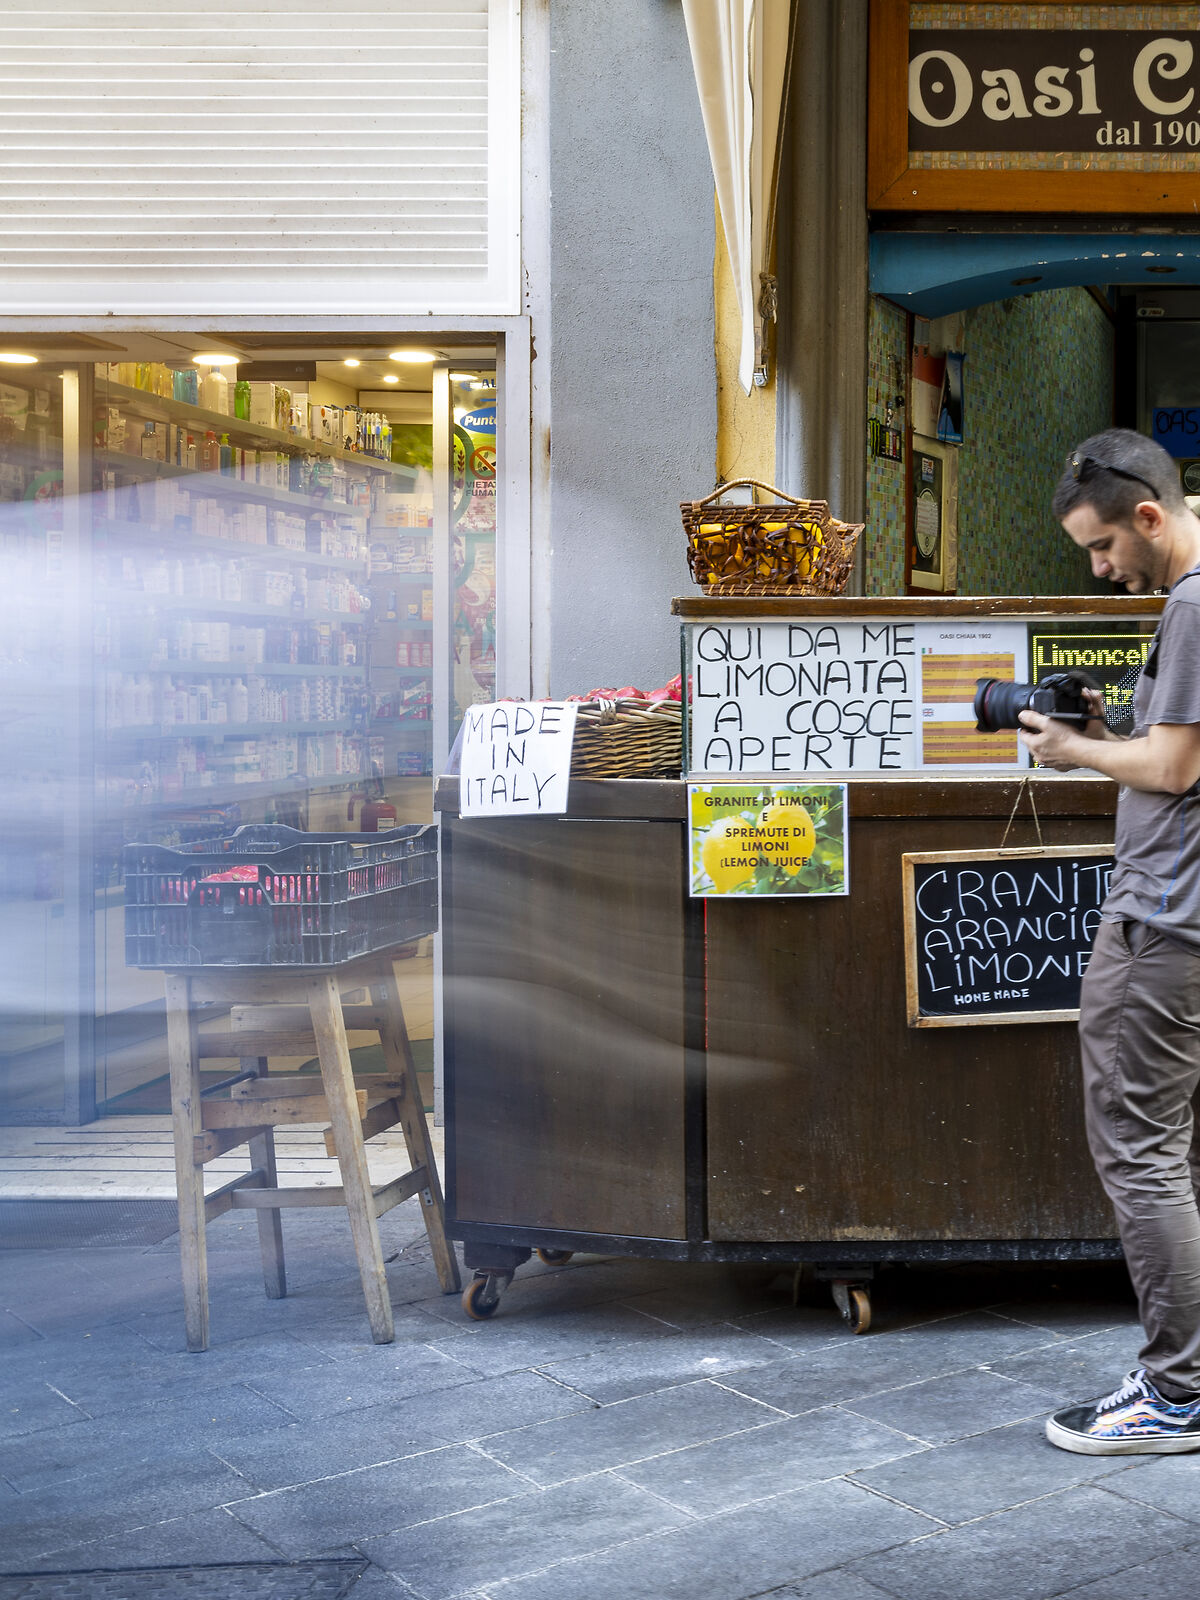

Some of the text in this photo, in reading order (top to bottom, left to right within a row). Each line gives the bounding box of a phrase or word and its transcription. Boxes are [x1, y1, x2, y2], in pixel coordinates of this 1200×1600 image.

[908, 47, 1102, 128] Oasi
[1096, 120, 1141, 146] dal
[697, 623, 915, 662] QUI DA ME
[1037, 642, 1151, 666] Limoncel
[697, 658, 908, 698] LIMONATA
[466, 706, 563, 744] MADE
[713, 699, 914, 737] A COSCE
[492, 738, 525, 769] IN
[704, 734, 902, 771] APERTE
[466, 772, 557, 809] ITALY
[704, 796, 827, 807] GRANITE DI LIMONI
[725, 827, 806, 838] SPREMUTE DI
[762, 812, 768, 822] E
[742, 841, 789, 852] LIMONI
[954, 988, 1030, 1006] HOME MADE
